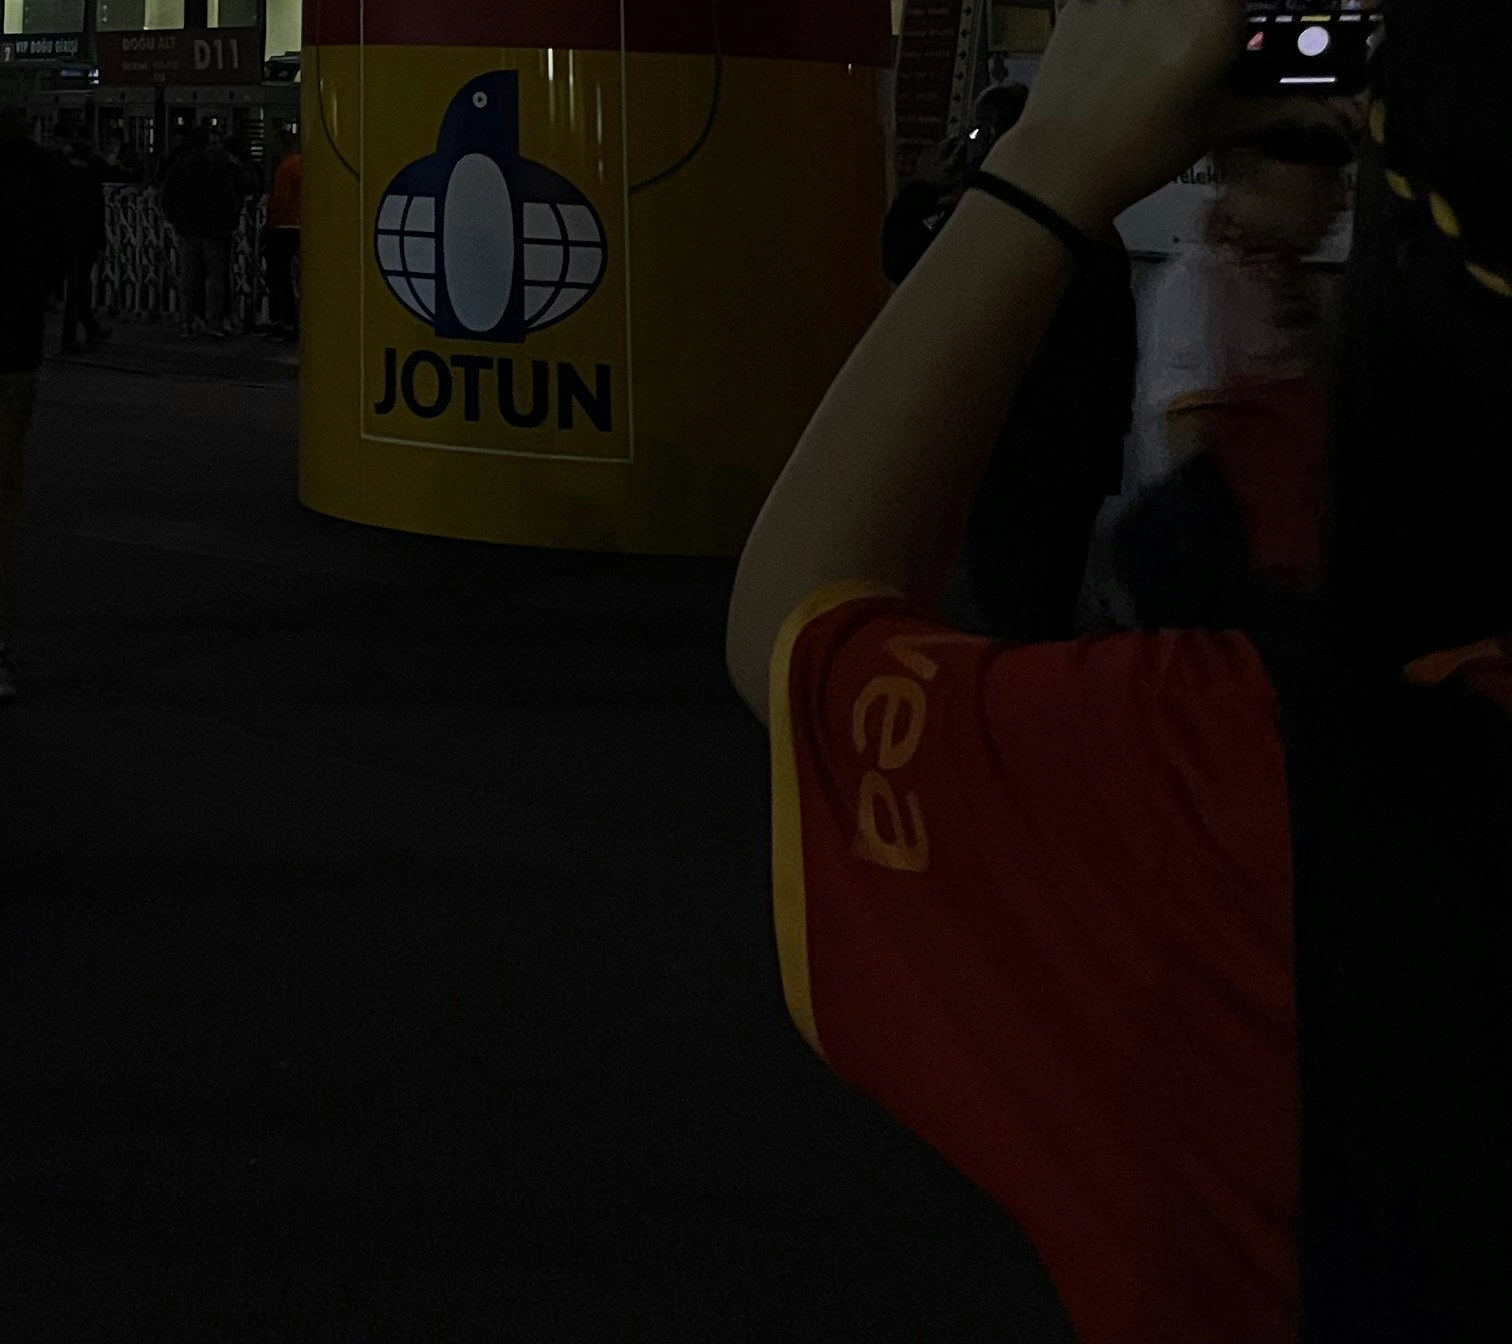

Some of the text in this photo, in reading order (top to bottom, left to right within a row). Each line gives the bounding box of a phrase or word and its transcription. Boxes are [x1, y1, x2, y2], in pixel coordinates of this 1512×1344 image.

[122, 33, 155, 52] DOĞU
[193, 38, 240, 71] D11
[372, 346, 612, 434] JOTUN
